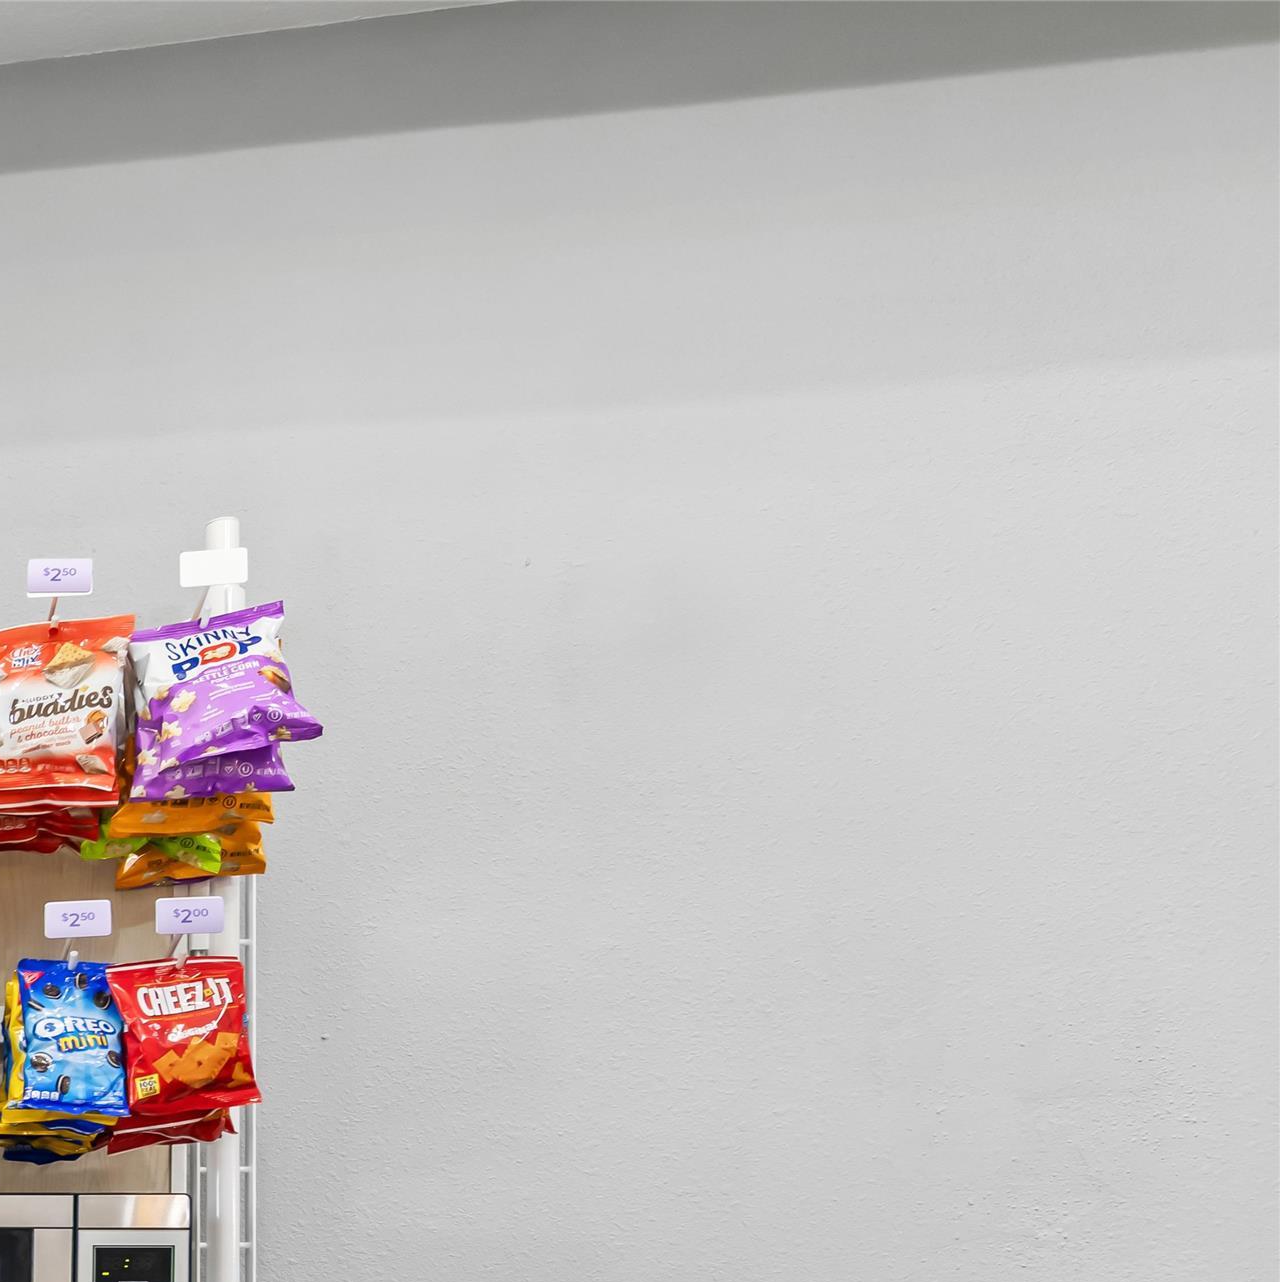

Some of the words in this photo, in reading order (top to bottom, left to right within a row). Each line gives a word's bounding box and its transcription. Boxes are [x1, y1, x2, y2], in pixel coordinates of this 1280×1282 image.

[165, 626, 252, 661] SKINNY
[9, 685, 114, 724] buddies
[35, 1017, 115, 1038] OREO
[59, 1034, 108, 1053] mini
